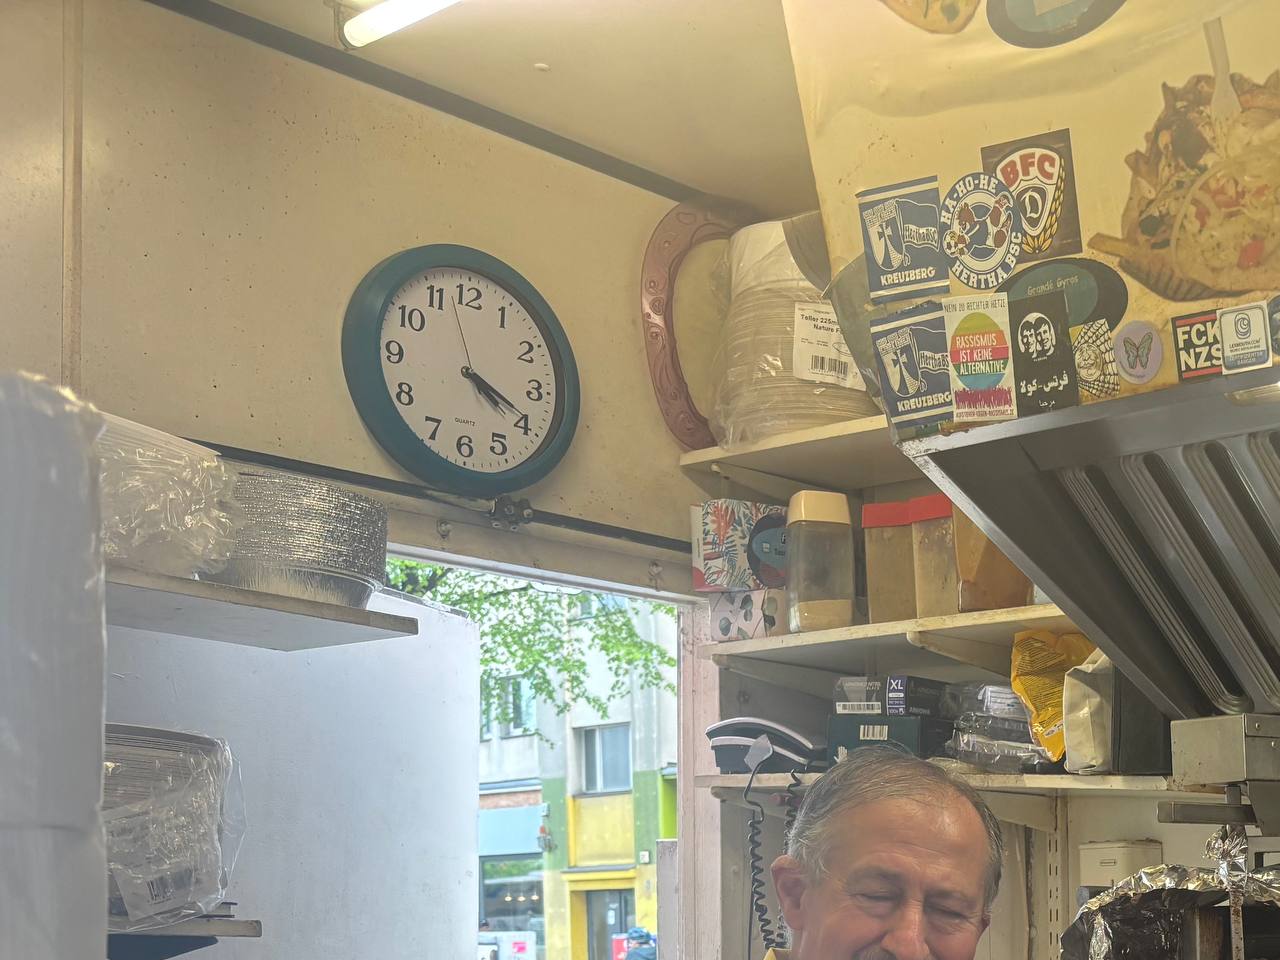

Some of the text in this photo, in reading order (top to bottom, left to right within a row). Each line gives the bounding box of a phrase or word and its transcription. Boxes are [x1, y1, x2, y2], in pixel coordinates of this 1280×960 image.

[1000, 152, 1056, 188] BFC
[880, 266, 936, 286] KREUZBERG
[426, 284, 444, 310] 11
[456, 283, 482, 310] 12
[398, 304, 426, 331] 10
[498, 306, 506, 329] 1
[956, 334, 997, 348] RASSISMUS
[1176, 321, 1222, 348] FCK
[385, 340, 404, 364] 9
[517, 340, 534, 363] 2
[960, 348, 992, 362] IST KEINE
[1180, 344, 1222, 371] NZS
[960, 360, 1005, 375] ALTERNATIVE
[395, 382, 414, 406] 8
[526, 379, 543, 401] 3
[897, 391, 952, 412] KREUZBERG
[424, 416, 442, 441] 7
[454, 417, 476, 427] QUARTZ
[513, 413, 532, 435] 4
[456, 435, 474, 457] 6
[489, 432, 508, 456] 5
[890, 679, 904, 690] XL
